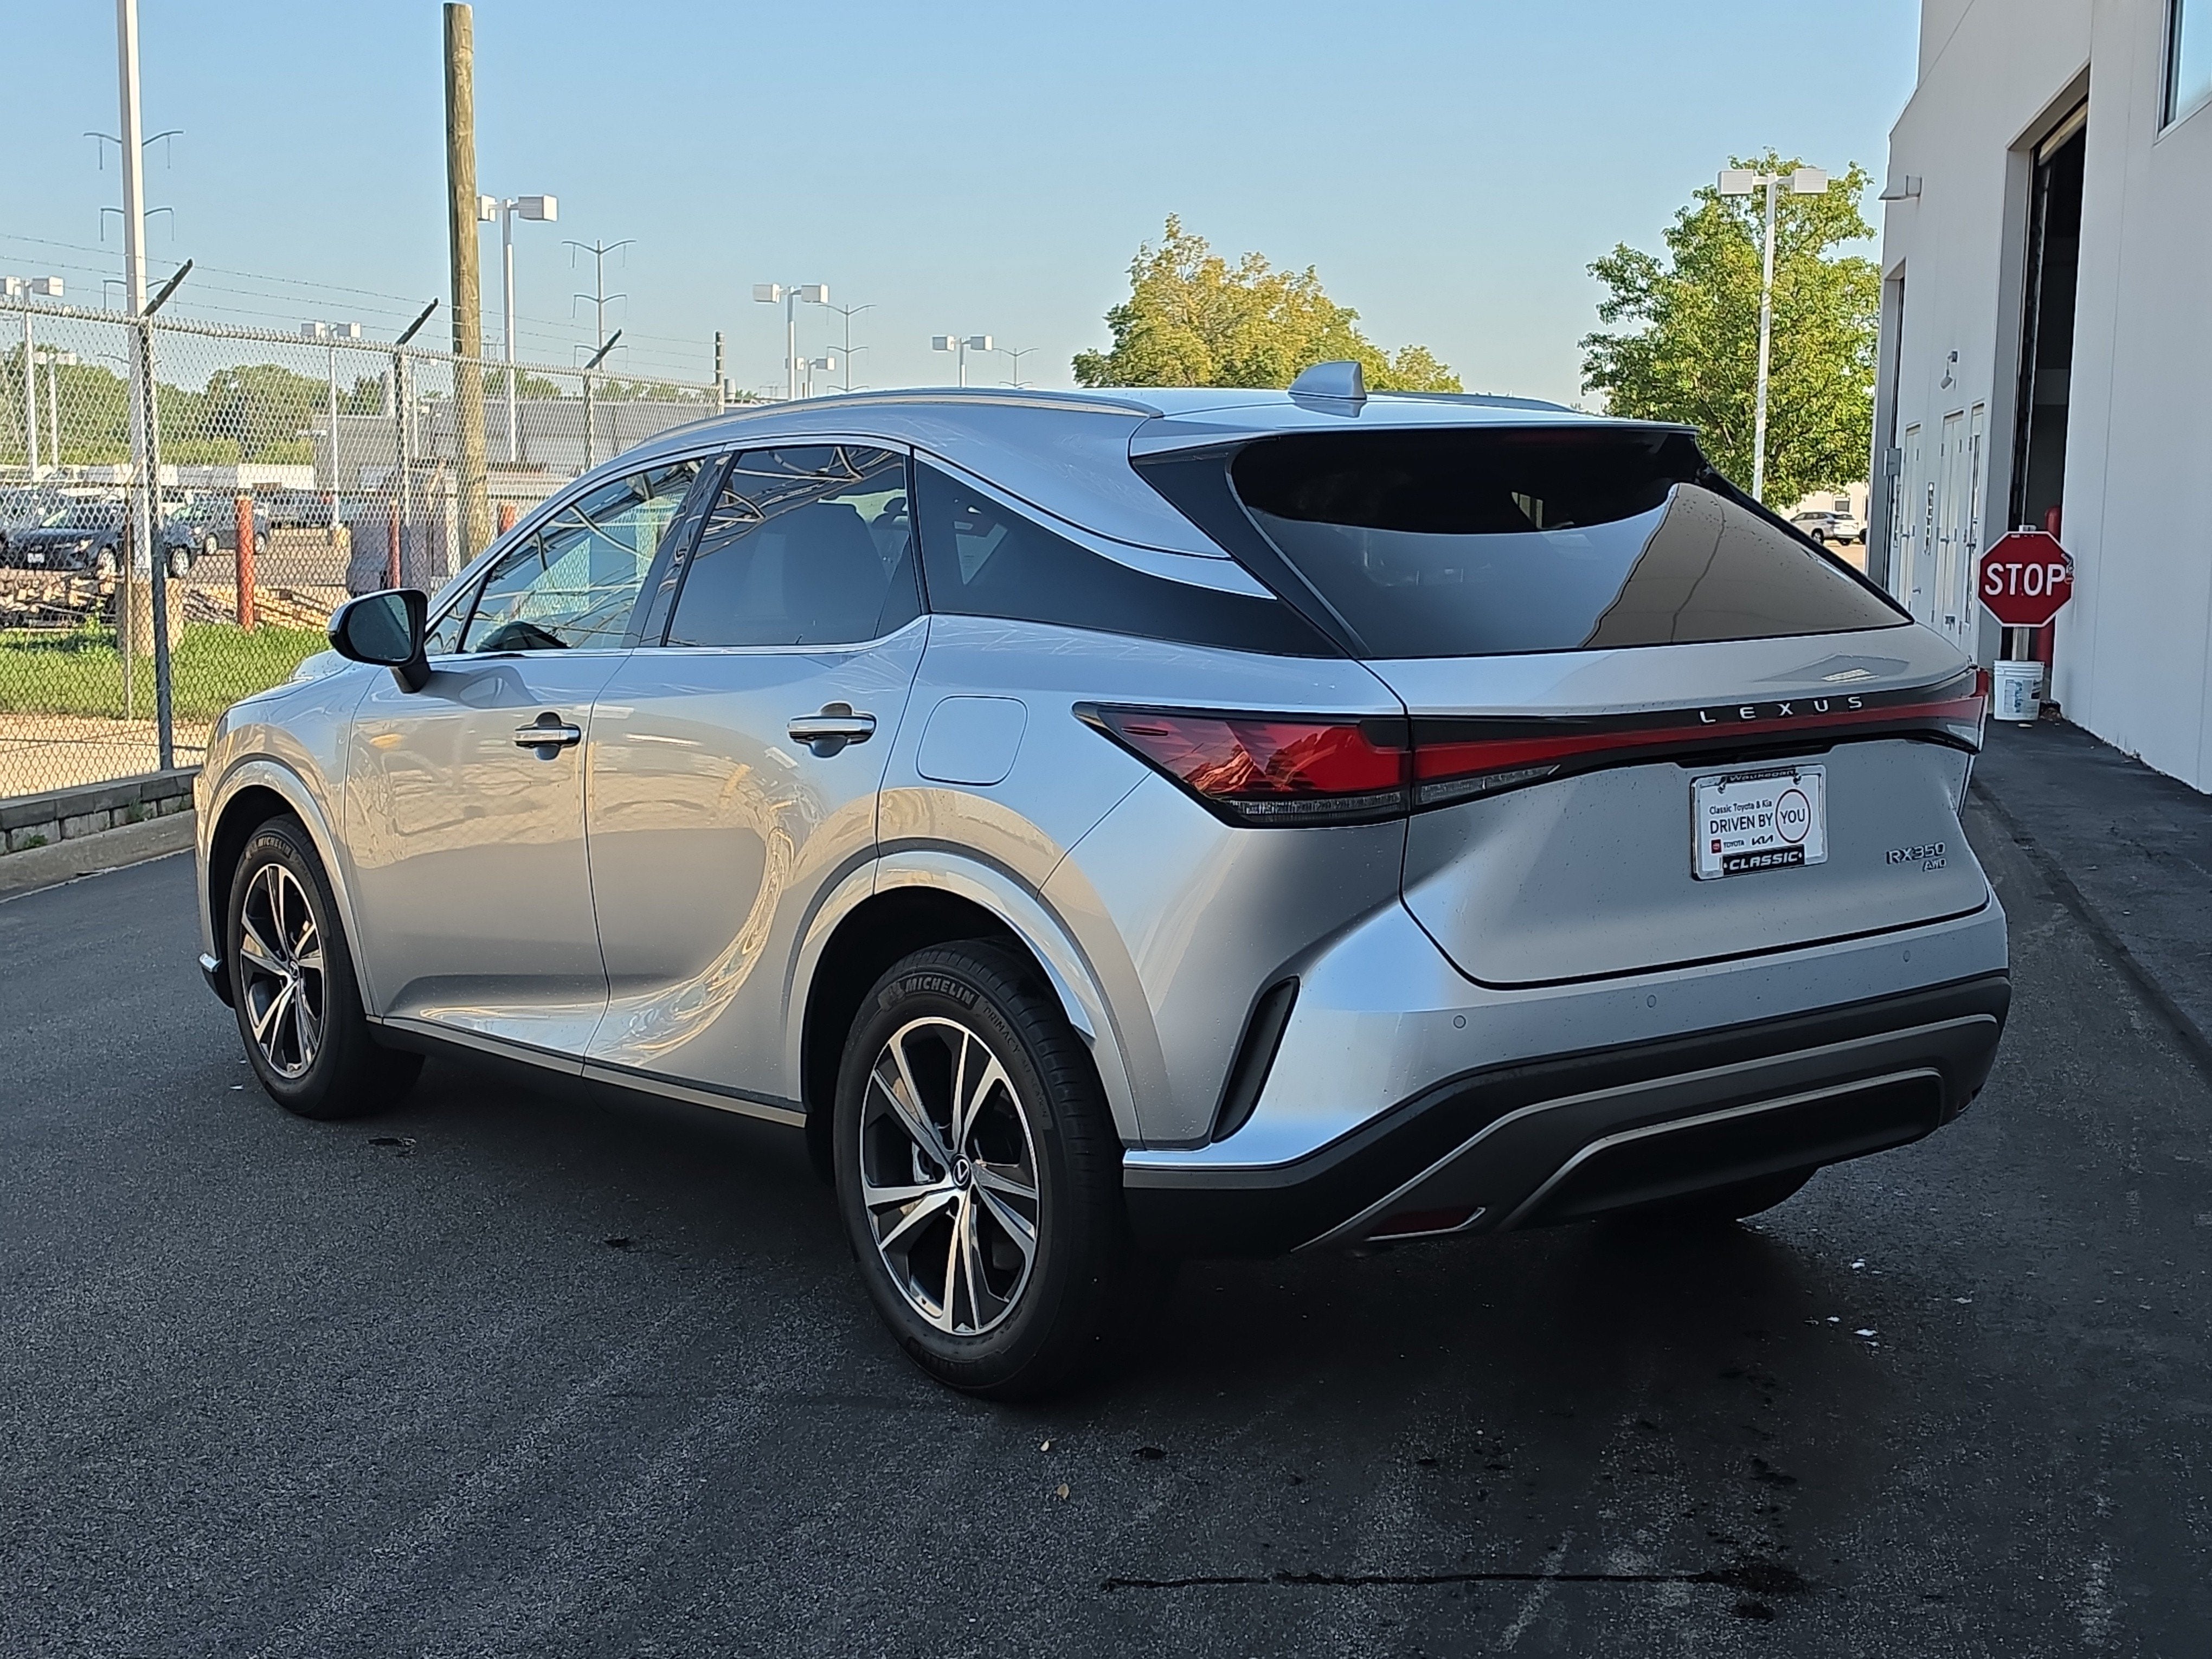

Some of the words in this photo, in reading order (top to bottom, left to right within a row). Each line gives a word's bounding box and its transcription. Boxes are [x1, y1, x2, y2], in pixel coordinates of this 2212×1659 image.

[1984, 562, 2066, 596] STOP
[1700, 696, 1863, 724] LEXUS
[1709, 805, 1732, 815] Classic
[1733, 803, 1754, 813] Toyota
[1762, 799, 1772, 808] Kia
[1710, 815, 1755, 834] DRIVEN
[1758, 812, 1773, 827] BY
[1779, 808, 1805, 824] YOU
[1723, 840, 1745, 848] TOYOTA
[1729, 851, 1798, 871] CLASSIC
[905, 976, 976, 1005] MICHELIN
[982, 1006, 1021, 1053] PRIMACY
